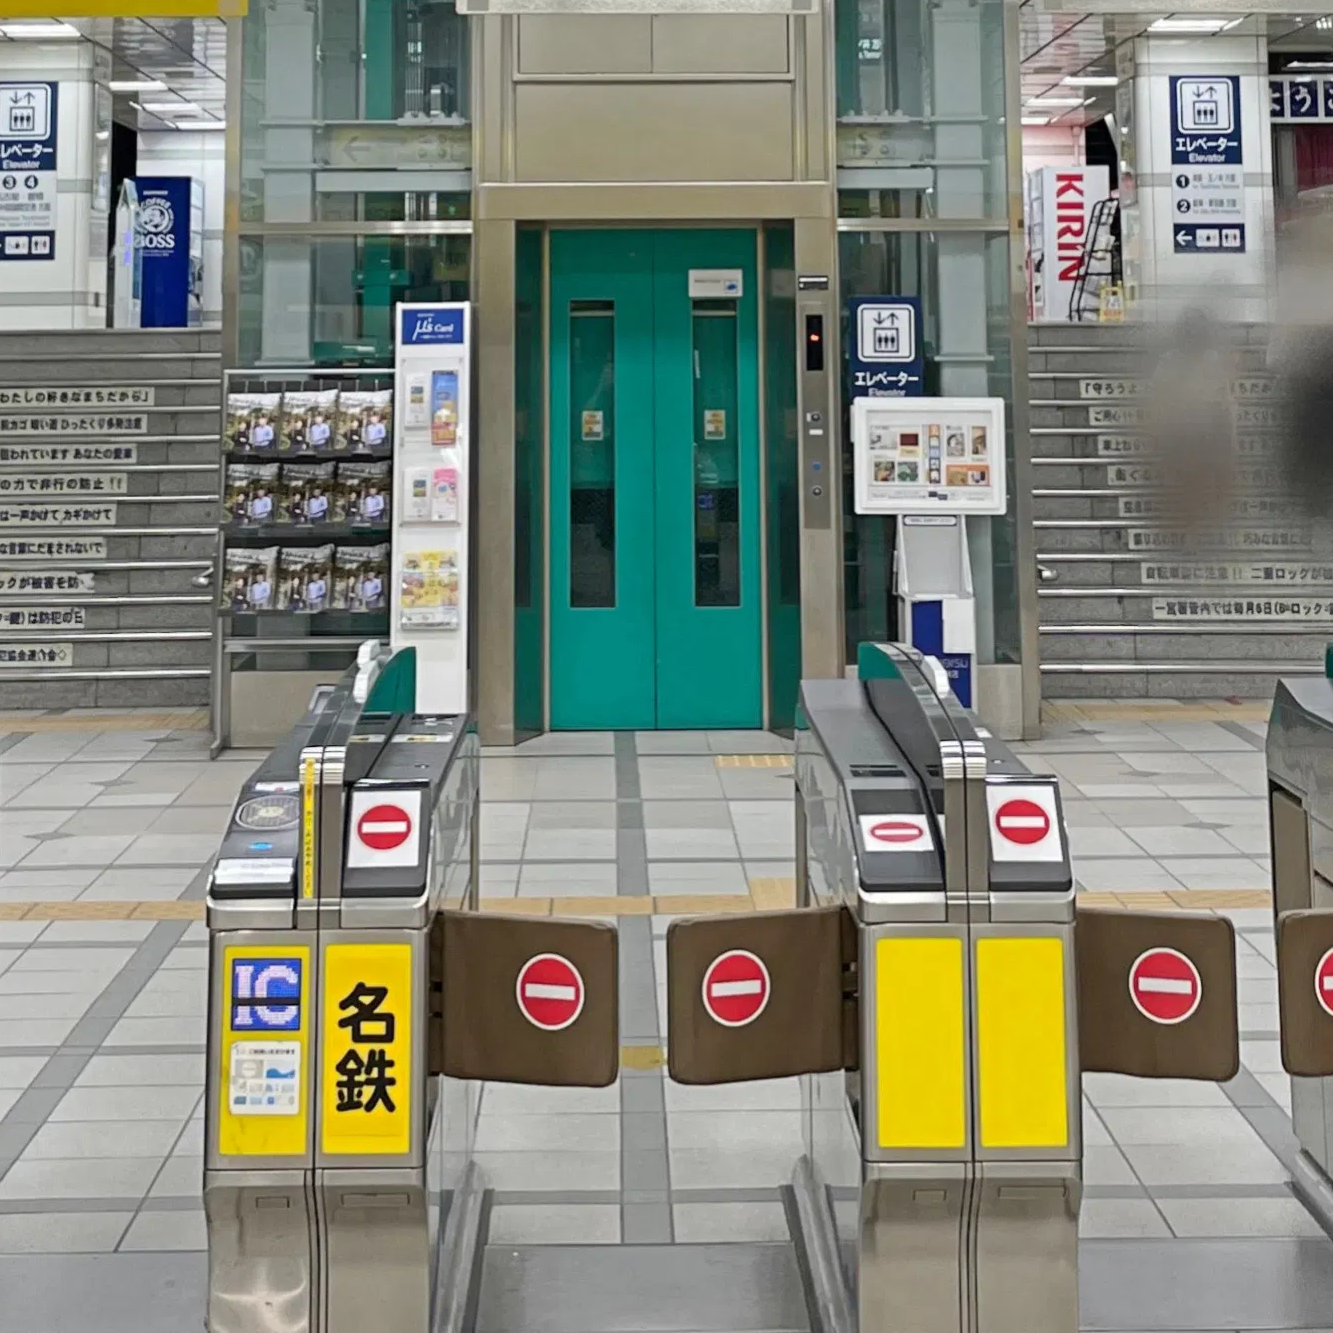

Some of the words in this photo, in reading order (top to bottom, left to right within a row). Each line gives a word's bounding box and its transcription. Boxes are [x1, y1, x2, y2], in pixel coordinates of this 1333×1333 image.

[1175, 137, 1239, 152] エレベーター
[2, 159, 41, 170] Elevator
[1188, 153, 1226, 163] Elevator
[1055, 172, 1085, 283] KIRIN
[854, 371, 919, 386] エレベーター
[234, 964, 299, 1026] IC
[336, 981, 397, 1114] 名鉄
